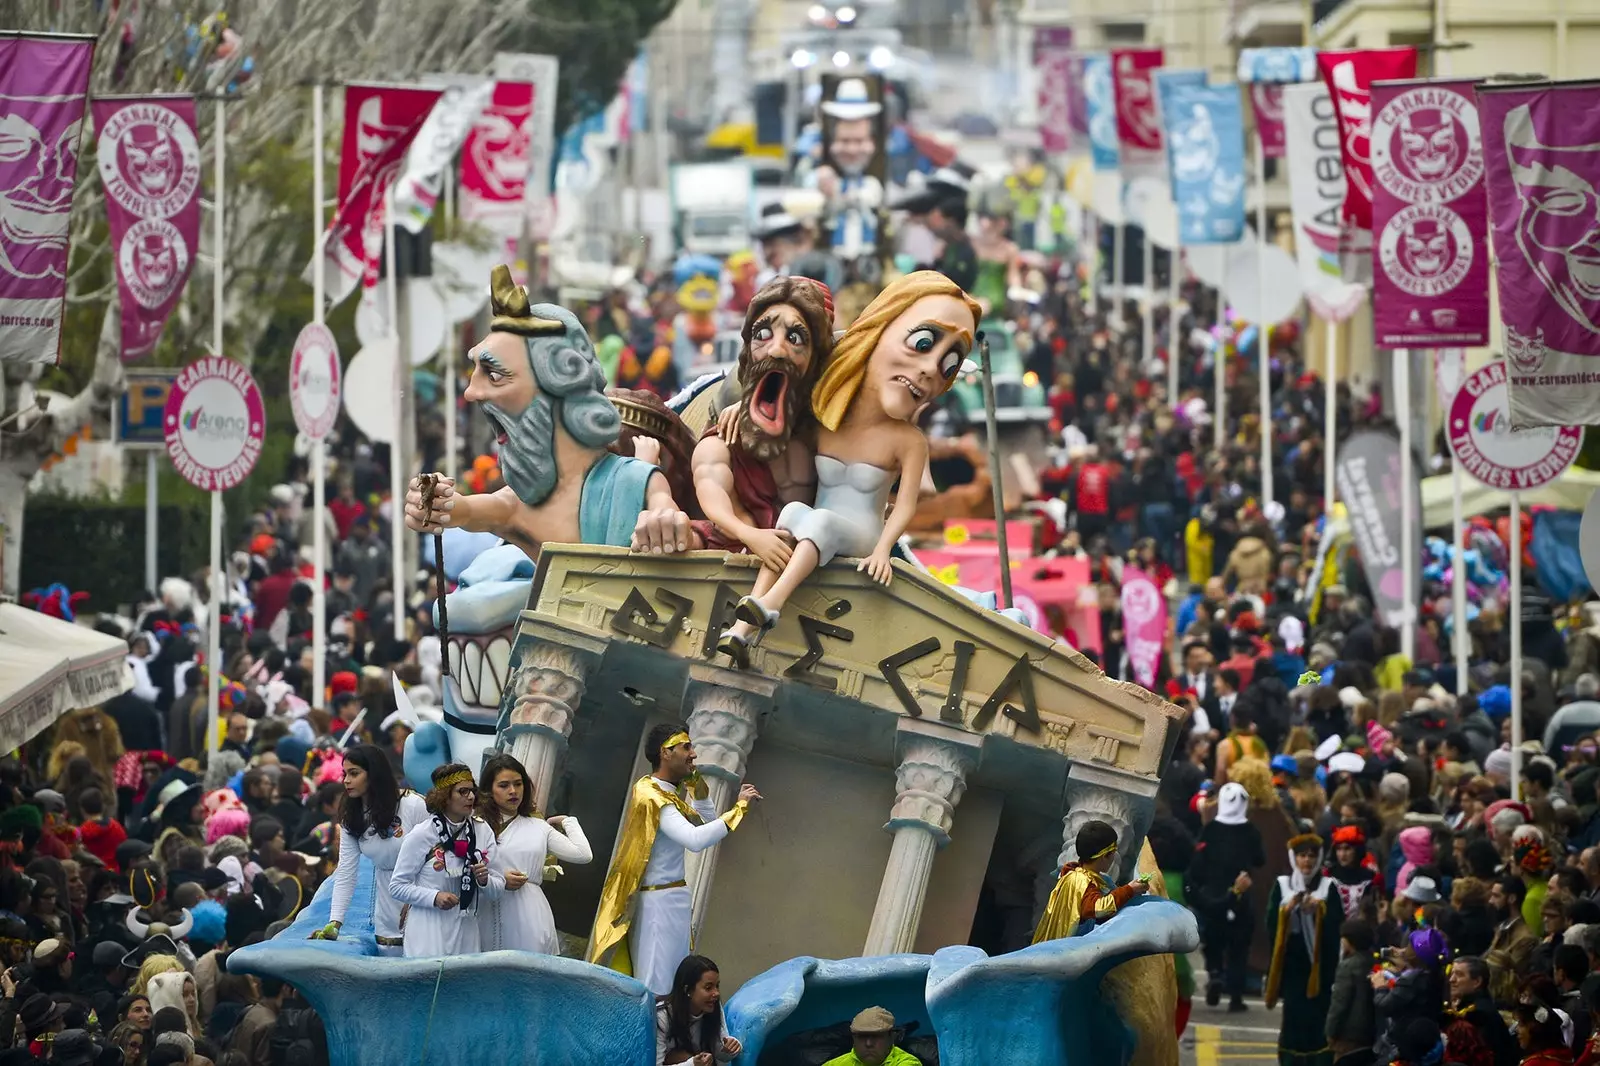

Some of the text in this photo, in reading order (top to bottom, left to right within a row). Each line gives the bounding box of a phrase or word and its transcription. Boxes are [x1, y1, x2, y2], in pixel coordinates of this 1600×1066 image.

[105, 107, 177, 140] CARNAVAL
[1382, 90, 1465, 126] CARNAVAL
[108, 164, 198, 217] TORRES VEDRAS
[1376, 148, 1483, 203] TORRES VEDRAS
[177, 358, 254, 397] CARNAVAL
[128, 380, 170, 424] P
[165, 430, 261, 491] TORRES VEDRAS
[1453, 432, 1578, 487] TORRES VEDRAS
